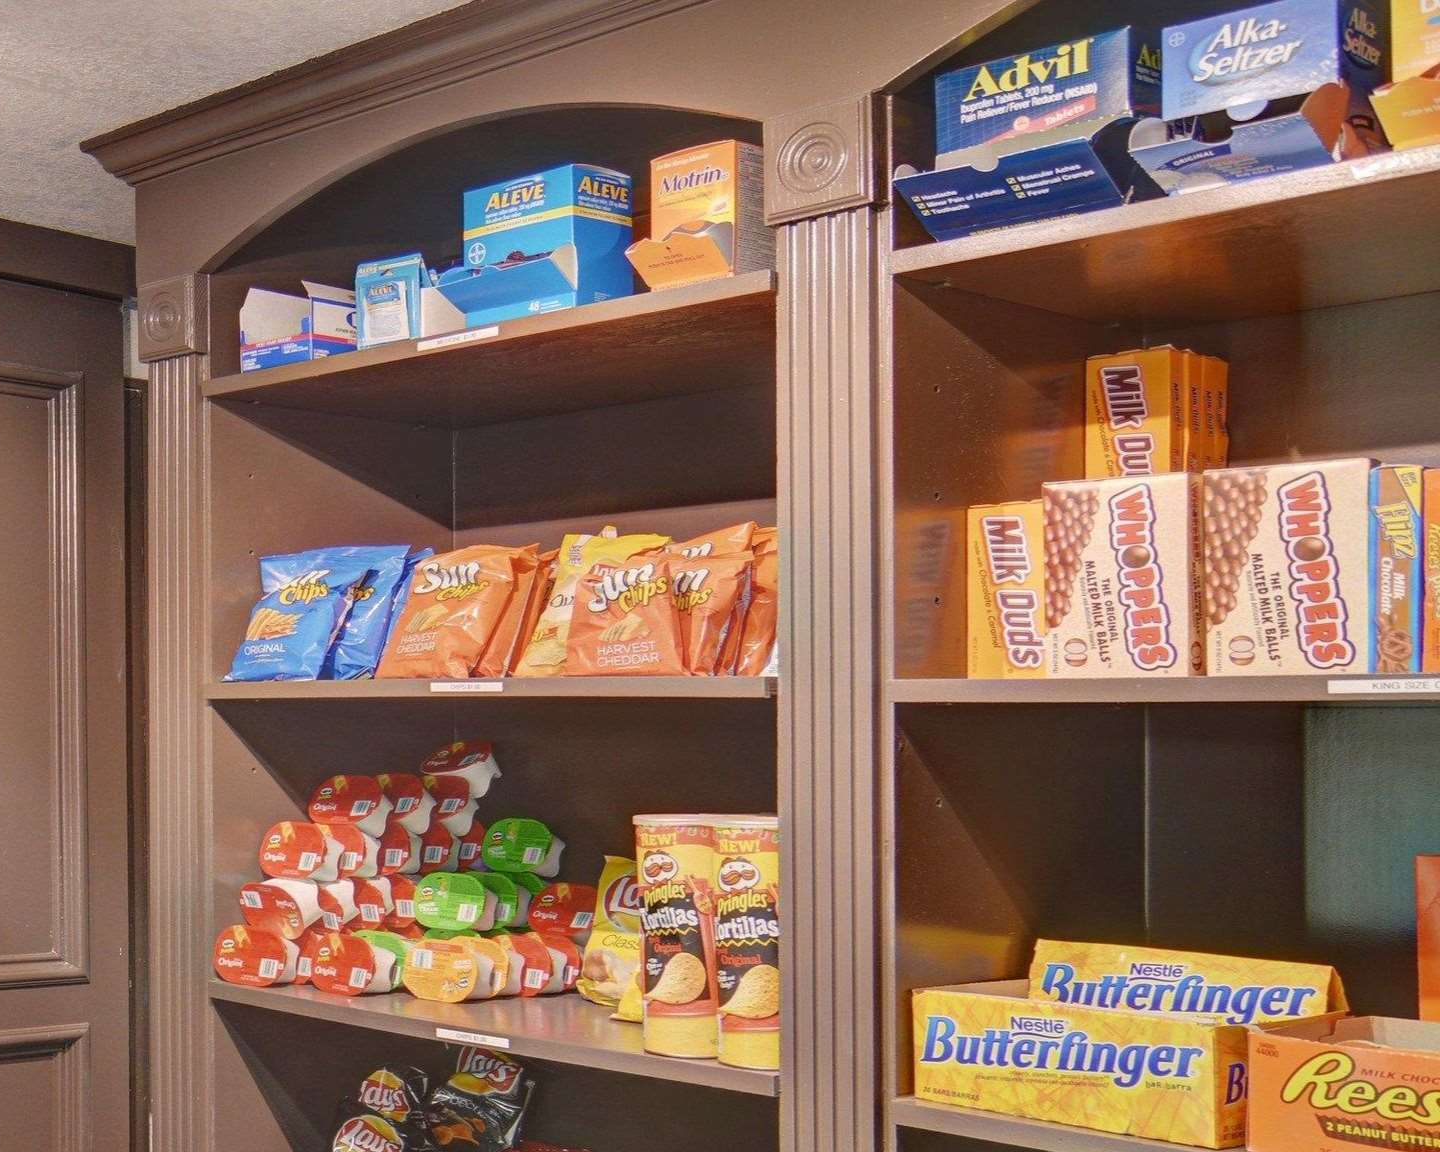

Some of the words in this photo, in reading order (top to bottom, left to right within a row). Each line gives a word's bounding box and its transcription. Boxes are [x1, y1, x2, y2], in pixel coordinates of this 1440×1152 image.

[1208, 17, 1287, 53] Alka-
[963, 40, 1090, 102] Advil
[1192, 41, 1302, 82] Seltzer
[1045, 104, 1086, 125] Tablets
[1174, 150, 1215, 166] ORIGINAL
[577, 176, 629, 203] ALEVE
[658, 166, 723, 196] Motrin
[485, 183, 546, 212] ALEVE
[1100, 365, 1148, 430] Milk
[1114, 433, 1154, 477] Du
[982, 516, 1030, 584] Milk
[414, 561, 481, 594] Sun
[1085, 560, 1100, 602] MALTED
[1113, 487, 1173, 667] WHOPPERS
[1251, 553, 1268, 595] MALTED
[1271, 572, 1280, 594] THE
[1283, 476, 1350, 666] WHOPPERS
[280, 584, 331, 605] Chips
[435, 582, 490, 601] Chips
[586, 562, 656, 614] Sun
[618, 576, 668, 614] Chips
[1102, 577, 1111, 599] THE
[1380, 556, 1393, 615] Chocolate
[1393, 572, 1407, 600] Milk
[1091, 602, 1105, 628] MILK
[1105, 600, 1119, 642] ORIGINAL
[1259, 594, 1272, 622] MILK
[1275, 594, 1290, 640] ORIGINAL
[399, 631, 439, 645] HARVEST
[996, 589, 1045, 669] Duds
[1265, 624, 1280, 661] BALLS
[244, 642, 286, 656] ORIGINAL
[596, 640, 656, 656] HARVEST
[597, 653, 660, 668] CHEDDAR
[1097, 631, 1110, 663] BALLS
[1372, 681, 1401, 690] KING
[1404, 681, 1430, 690] SIZE
[640, 832, 678, 847] NEW!
[718, 839, 761, 853] NEW!
[644, 882, 686, 907] Pringles
[718, 890, 768, 916] Pringles
[640, 907, 698, 931] Tortillas
[715, 915, 779, 940] Tortillas
[1041, 962, 1317, 1025] Butterfinger
[920, 1016, 1203, 1088] Butterfinger
[1361, 1067, 1397, 1080] MILK
[1326, 1121, 1335, 1132] 2
[1337, 1122, 1388, 1141] PEANUT
[1391, 1132, 1440, 1148] BUTTER
